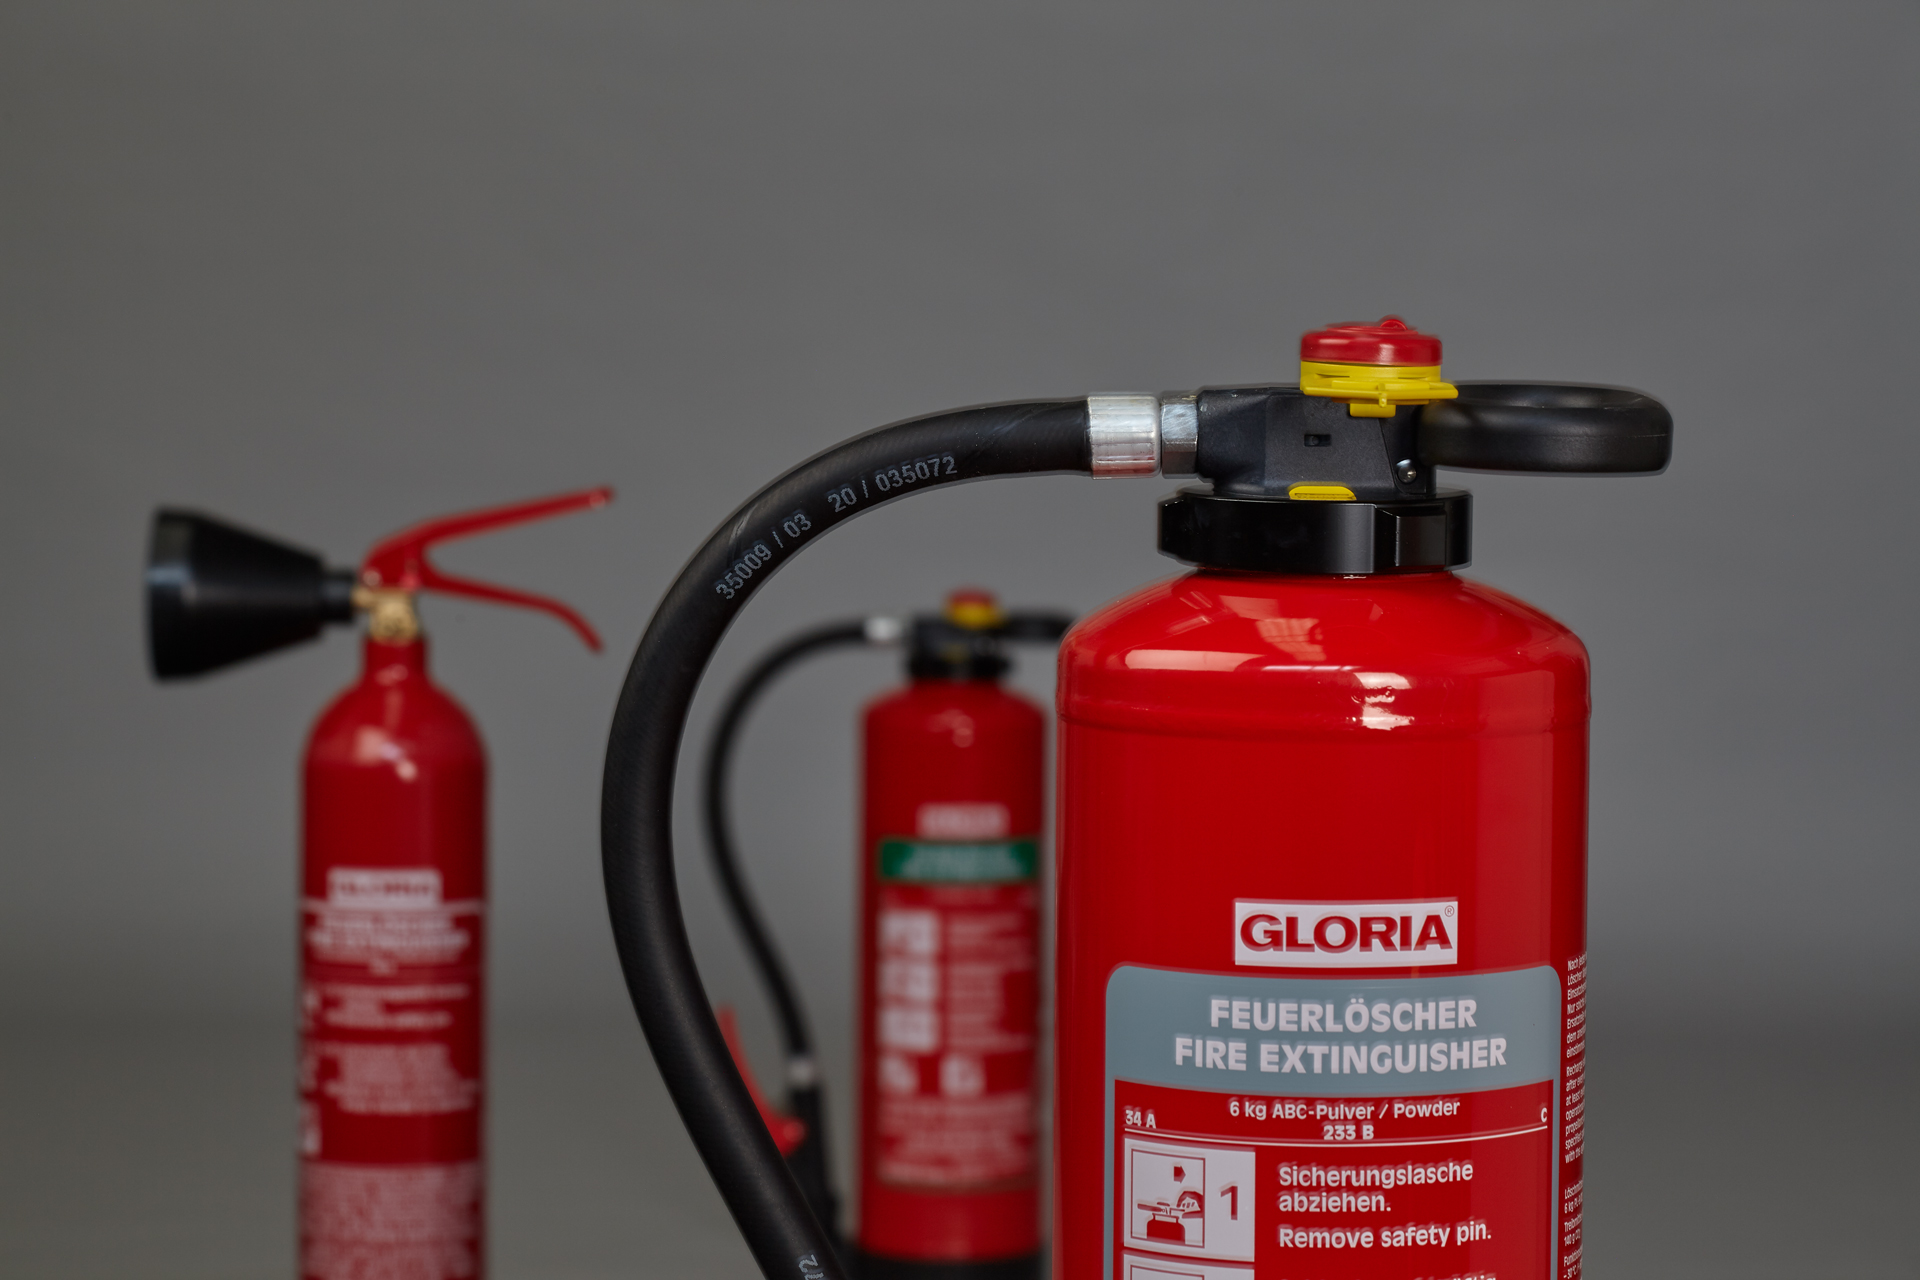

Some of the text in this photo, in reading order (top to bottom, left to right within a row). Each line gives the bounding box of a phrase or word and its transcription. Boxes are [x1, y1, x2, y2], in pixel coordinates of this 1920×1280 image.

[715, 544, 773, 600] 35009
[783, 513, 812, 539] 03
[827, 486, 858, 514] 20
[875, 455, 958, 493] 035072
[1211, 998, 1477, 1033] FEUERLÖSCHER
[1175, 1037, 1507, 1074] FIRE EXTINGUISHER
[1125, 1109, 1157, 1129] 34 A
[1229, 1101, 1461, 1121] 6 kg ABC-Pulver / Powder
[1540, 1107, 1548, 1123] C
[1323, 1124, 1374, 1141] 233 B
[1279, 1163, 1474, 1189] Sicherungslasche
[1220, 1185, 1239, 1221] 1
[1279, 1191, 1392, 1213] abziehen.
[1279, 1220, 1493, 1249] Remove safety pin.
